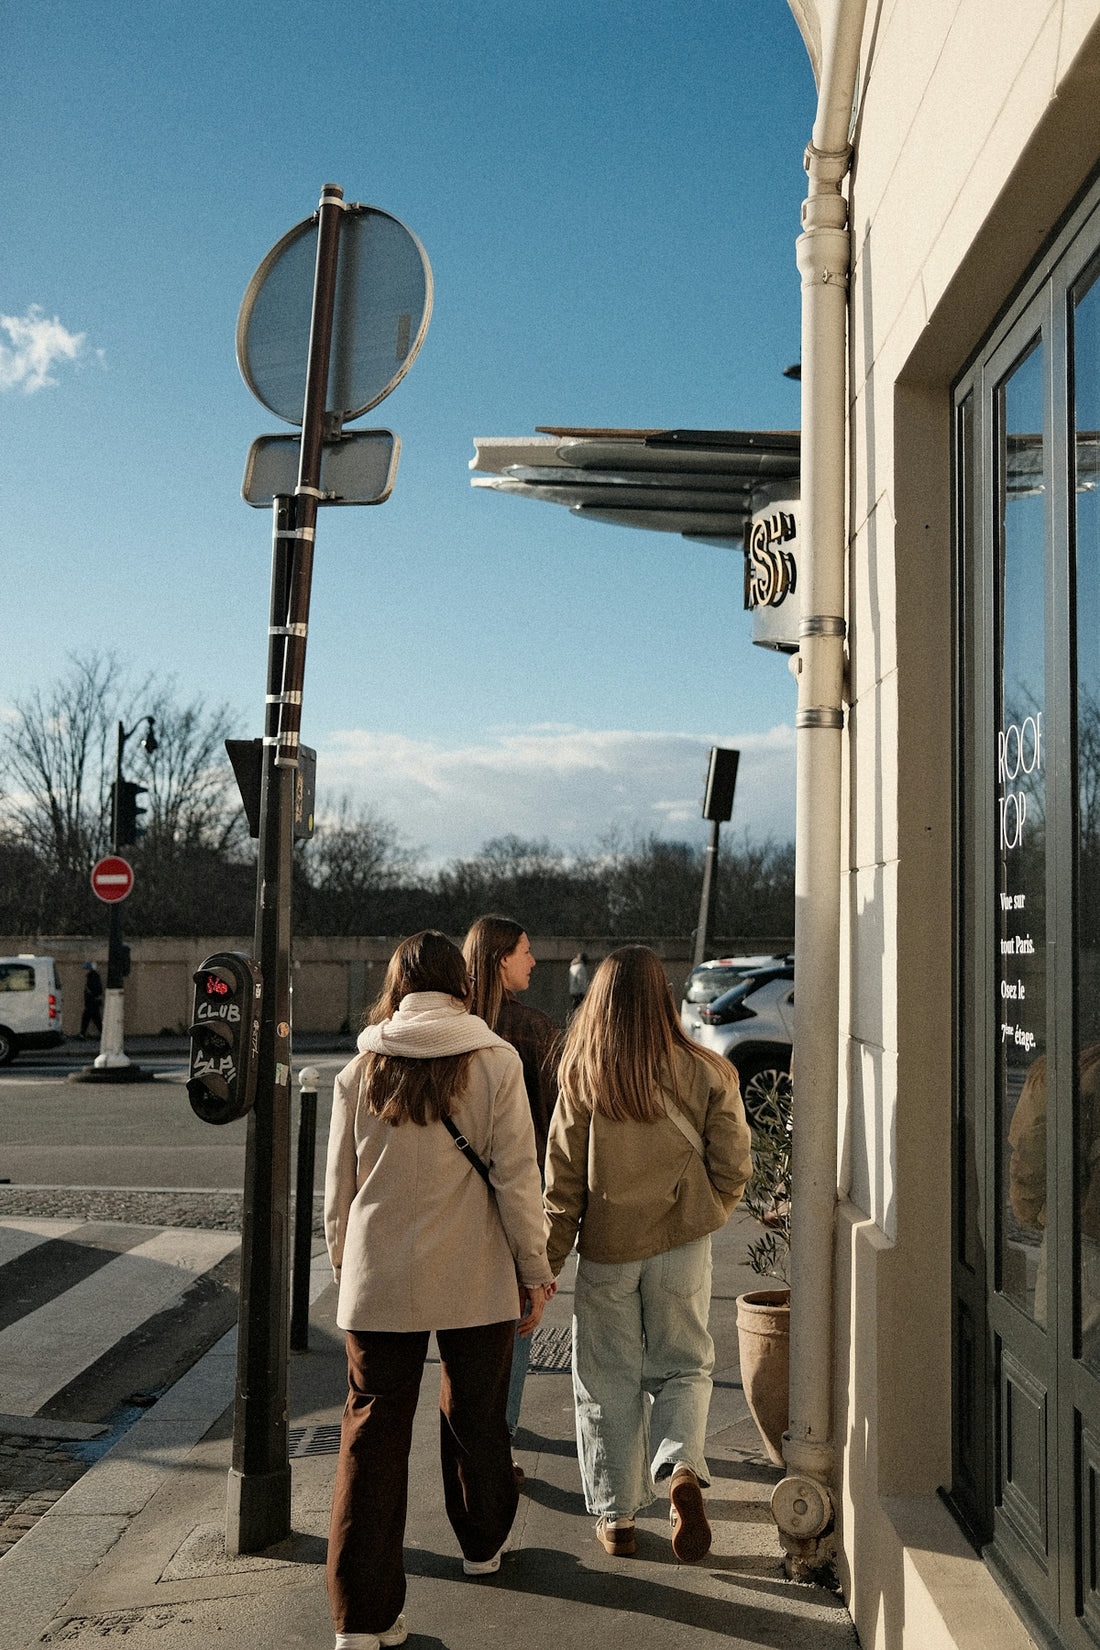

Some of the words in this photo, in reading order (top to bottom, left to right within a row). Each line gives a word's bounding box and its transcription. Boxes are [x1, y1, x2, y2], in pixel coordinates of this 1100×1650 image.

[998, 712, 1042, 784] ROOF
[998, 791, 1027, 851] TOP
[1000, 892, 1013, 910] Vue
[1013, 894, 1026, 909] sur
[1000, 938, 1015, 954] tout
[1015, 933, 1035, 954] Paris.
[1000, 980, 1017, 999] Osez
[1017, 979, 1025, 1000] le
[197, 1002, 241, 1023] CLUB
[1014, 1024, 1036, 1052] étage.
